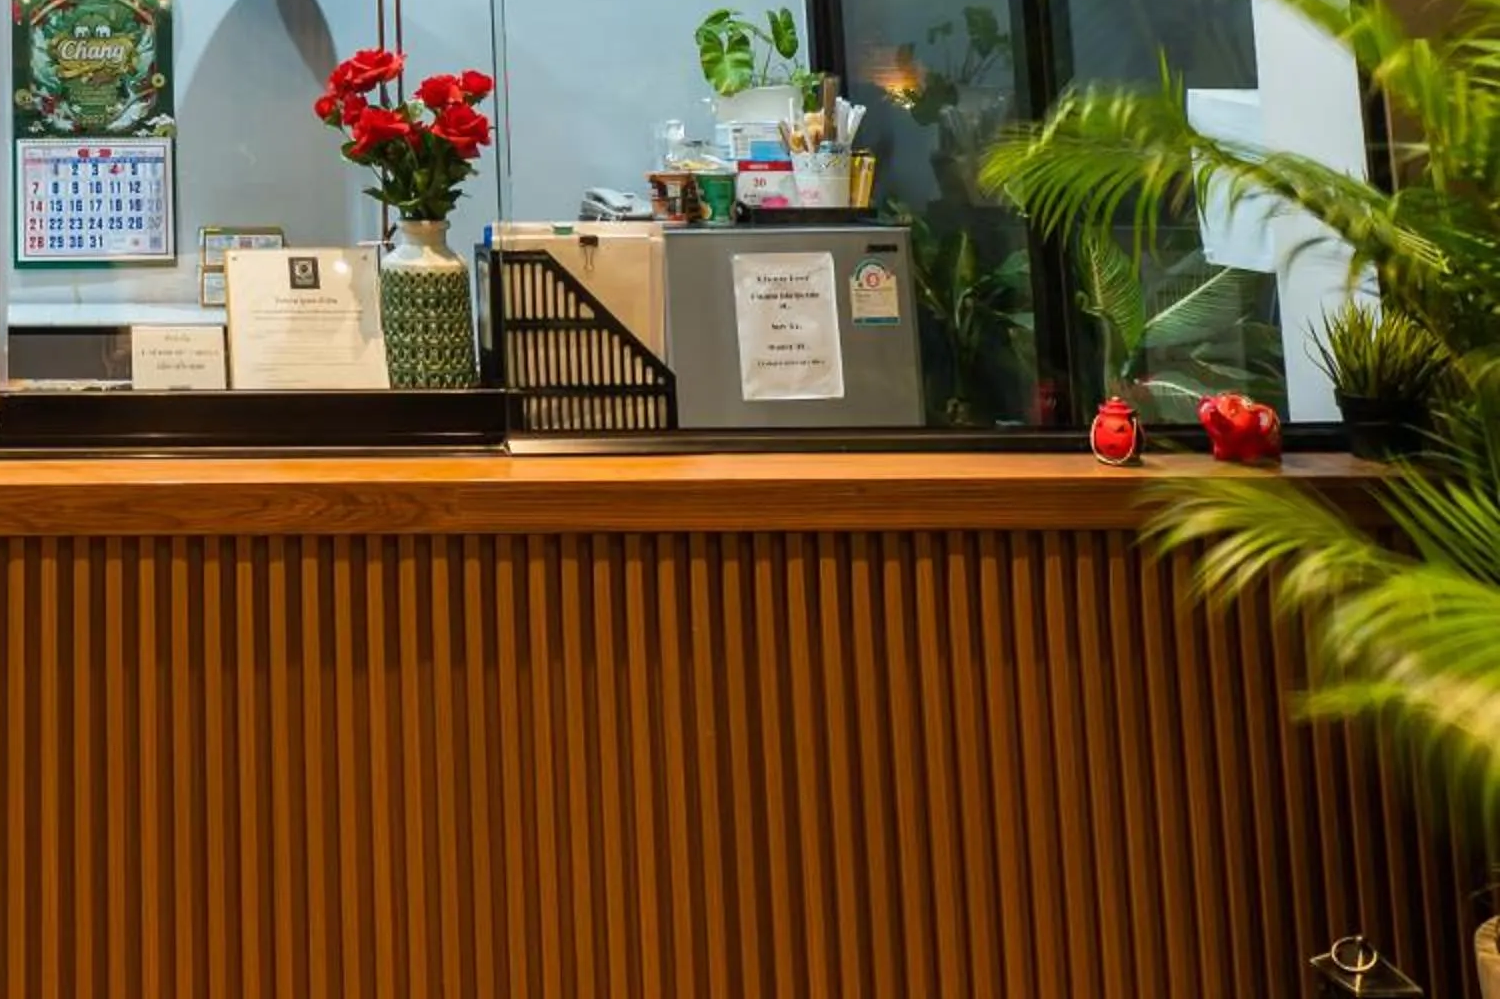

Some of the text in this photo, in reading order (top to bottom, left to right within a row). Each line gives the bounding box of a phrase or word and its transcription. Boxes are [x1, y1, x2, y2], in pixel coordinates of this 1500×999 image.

[58, 39, 126, 62] Chang
[71, 162, 79, 176] 2
[91, 162, 99, 176] 3
[32, 181, 39, 194] 7
[89, 181, 102, 194] 10
[109, 181, 121, 194] 11
[129, 181, 141, 194] 12
[30, 199, 42, 212] 14
[50, 199, 63, 212] 15
[70, 199, 83, 212] 16
[89, 199, 102, 212] 17
[29, 217, 43, 230] 21
[49, 217, 63, 230] 22
[69, 217, 83, 230] 23
[89, 217, 103, 230] 24
[108, 217, 123, 230] 25
[128, 217, 143, 230] 26
[29, 235, 44, 249] 28
[49, 235, 64, 249] 29
[89, 235, 103, 249] 31
